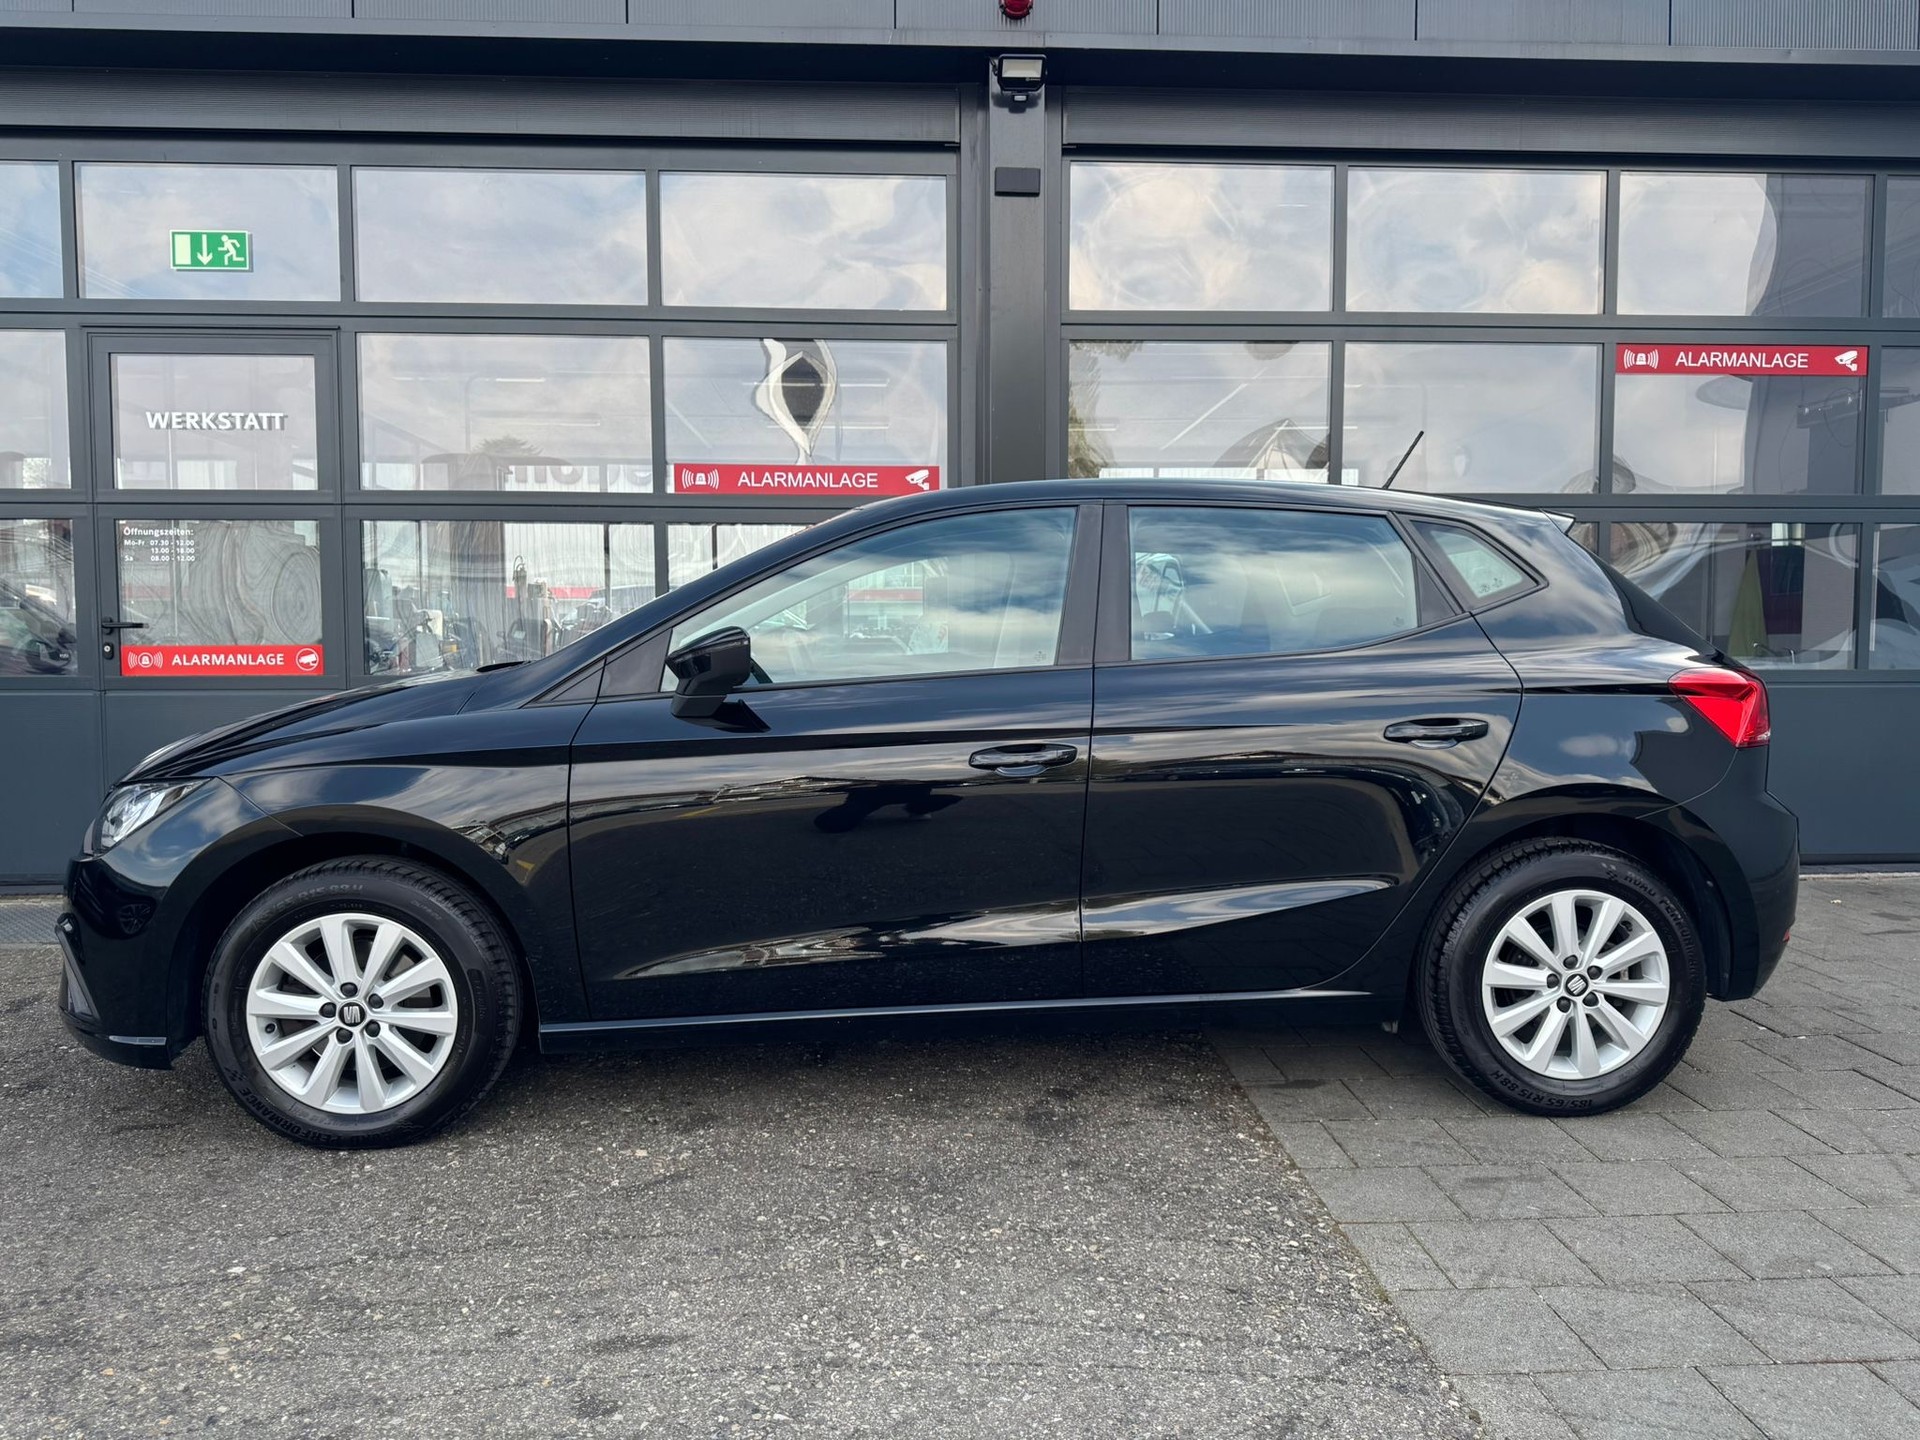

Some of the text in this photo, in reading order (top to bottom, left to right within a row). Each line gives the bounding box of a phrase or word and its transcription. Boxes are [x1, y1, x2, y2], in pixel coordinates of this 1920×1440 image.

[1675, 351, 1809, 368] ALARMANLAGE
[145, 411, 284, 430] WERKSTATT
[737, 471, 879, 488] ALARMANLAGE
[123, 526, 194, 537] Öffnungszeiten:
[171, 653, 285, 667] ALARMANLAGE
[1518, 1088, 1543, 1103] R15
[1545, 1098, 1593, 1109] 185/65
